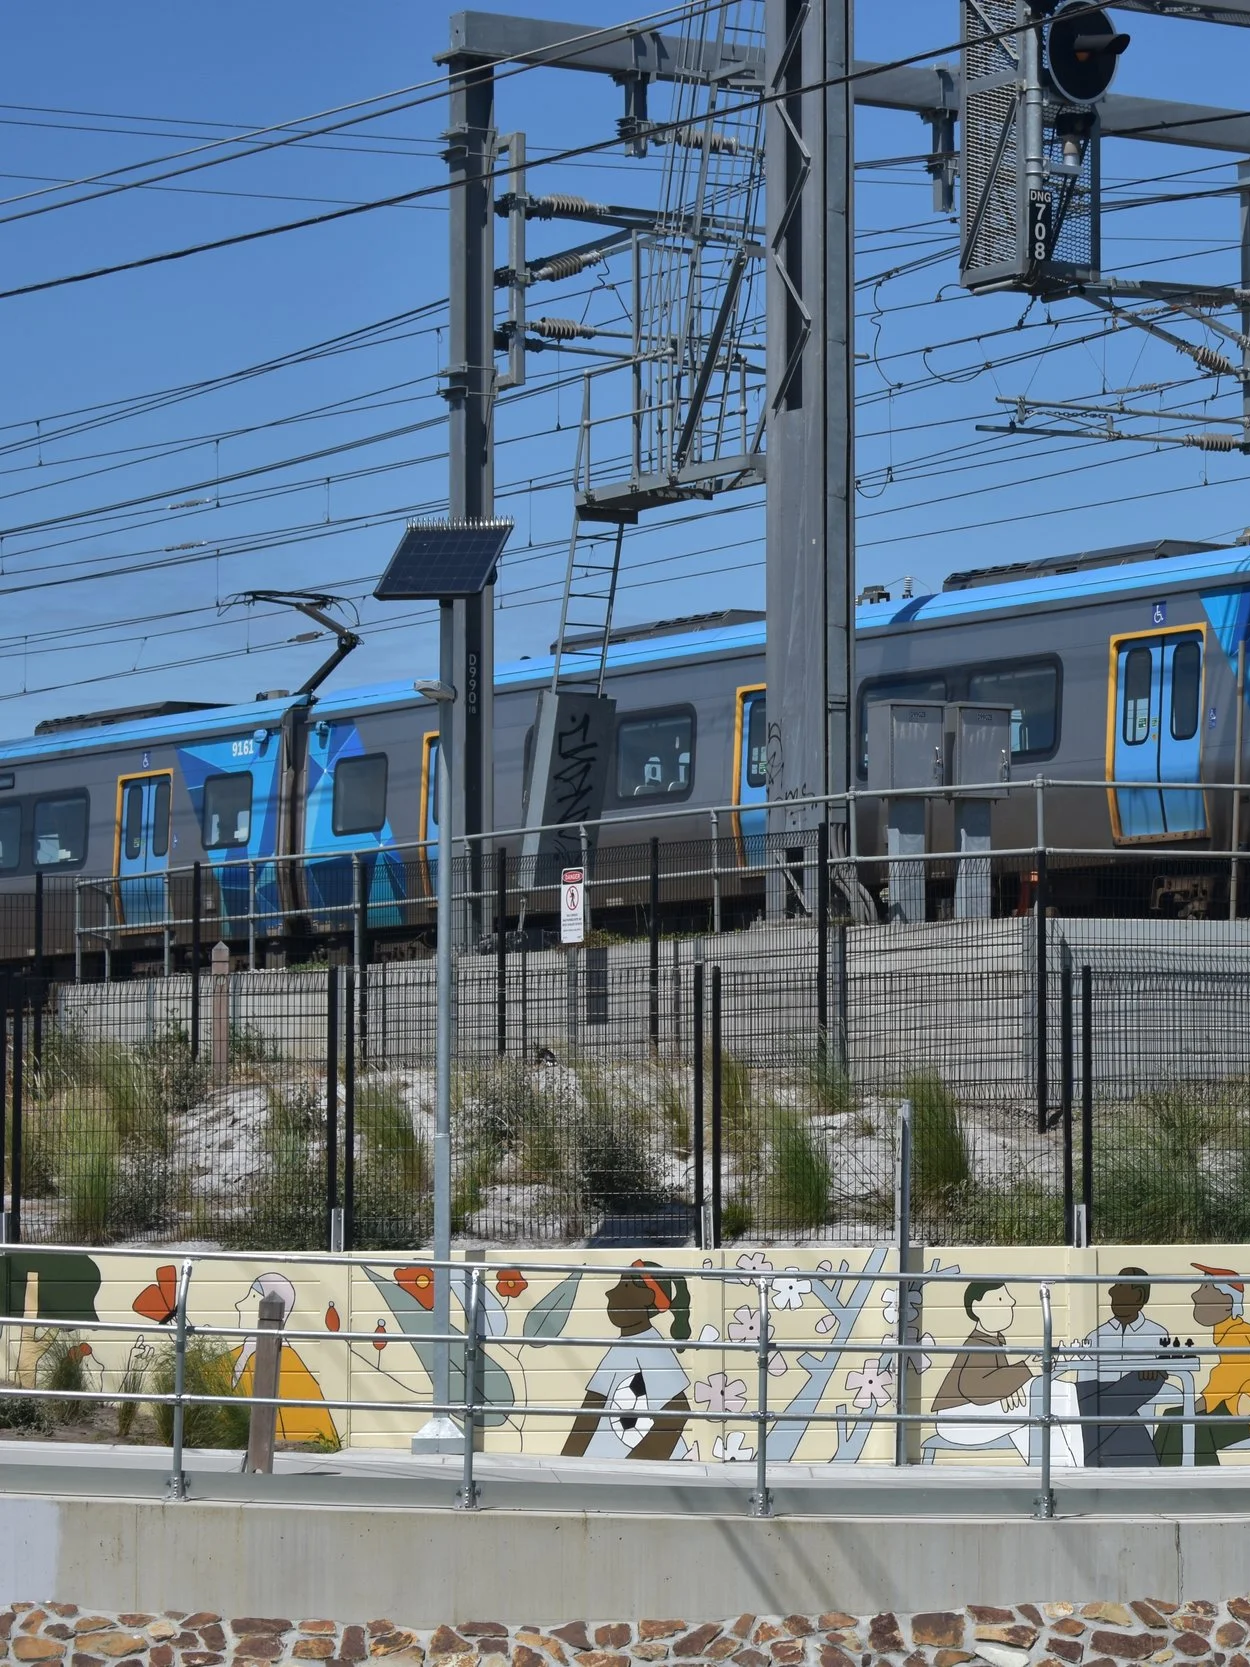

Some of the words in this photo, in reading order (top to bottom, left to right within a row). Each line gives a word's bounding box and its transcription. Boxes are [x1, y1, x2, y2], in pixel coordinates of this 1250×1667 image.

[1030, 190, 1052, 203] DNG
[1034, 203, 1046, 260] 708
[468, 653, 477, 704] D990
[232, 739, 254, 757] 9161
